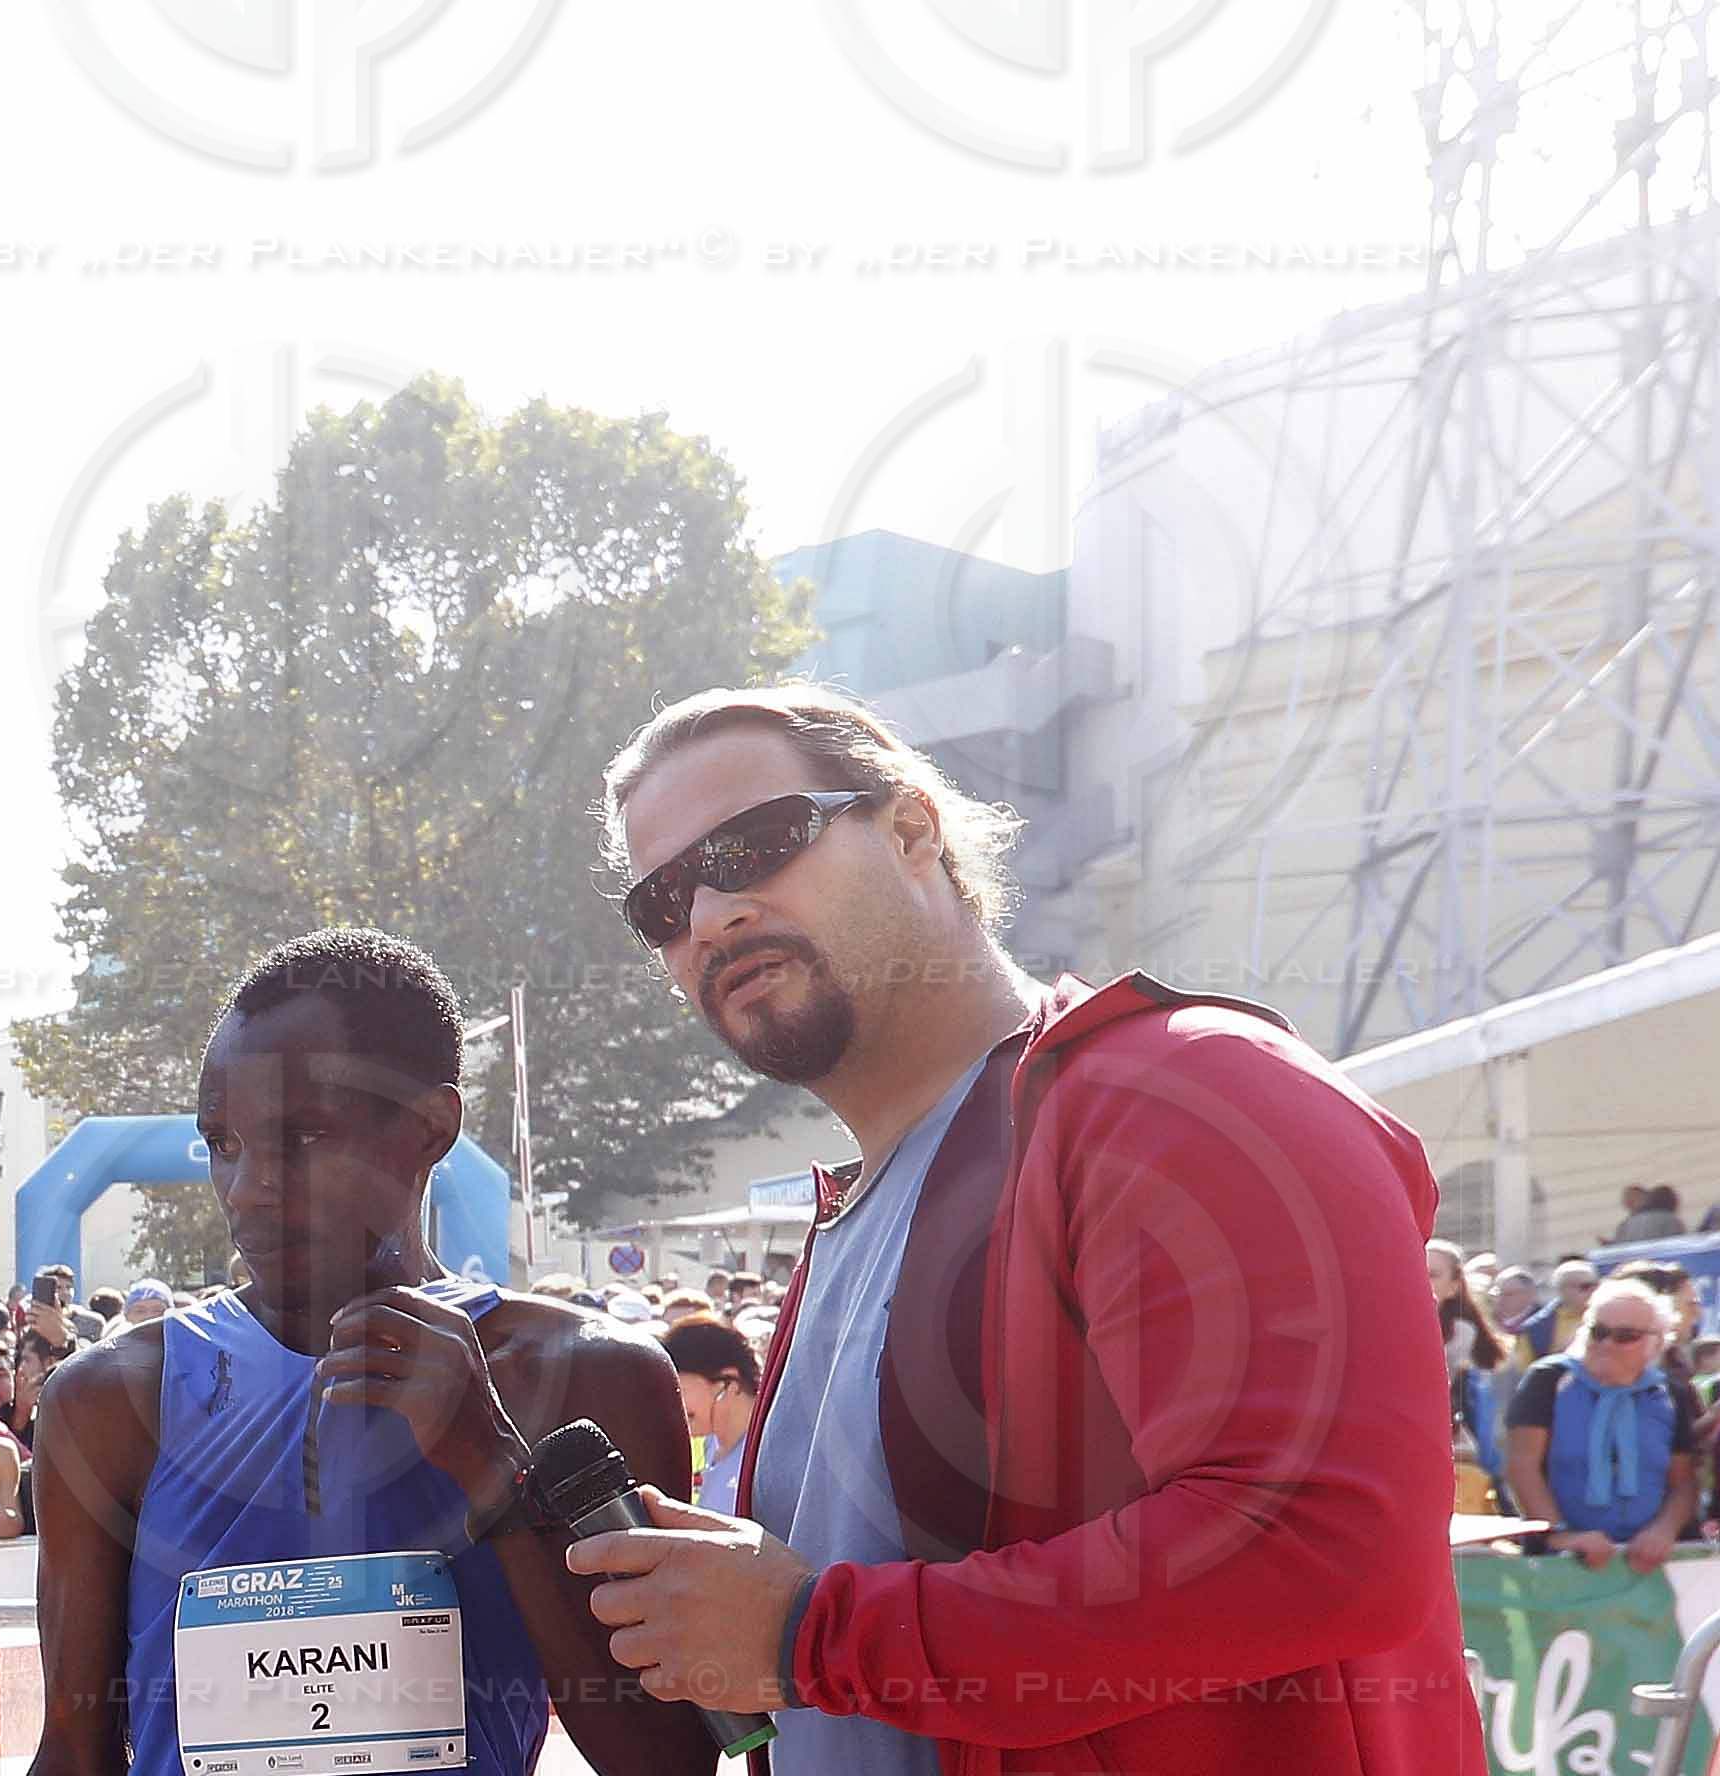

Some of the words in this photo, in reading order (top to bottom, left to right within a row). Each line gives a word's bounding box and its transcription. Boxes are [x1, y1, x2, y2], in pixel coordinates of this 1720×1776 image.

[231, 1568, 304, 1594] GRAZ
[327, 1575, 343, 1585] 25
[391, 1583, 405, 1597] M
[217, 1594, 283, 1609] MARATHON
[395, 1594, 415, 1606] JK
[265, 1606, 295, 1617] 2018
[247, 1641, 390, 1680] KARANI
[303, 1684, 335, 1694] ELITE
[311, 1702, 331, 1731] 2
